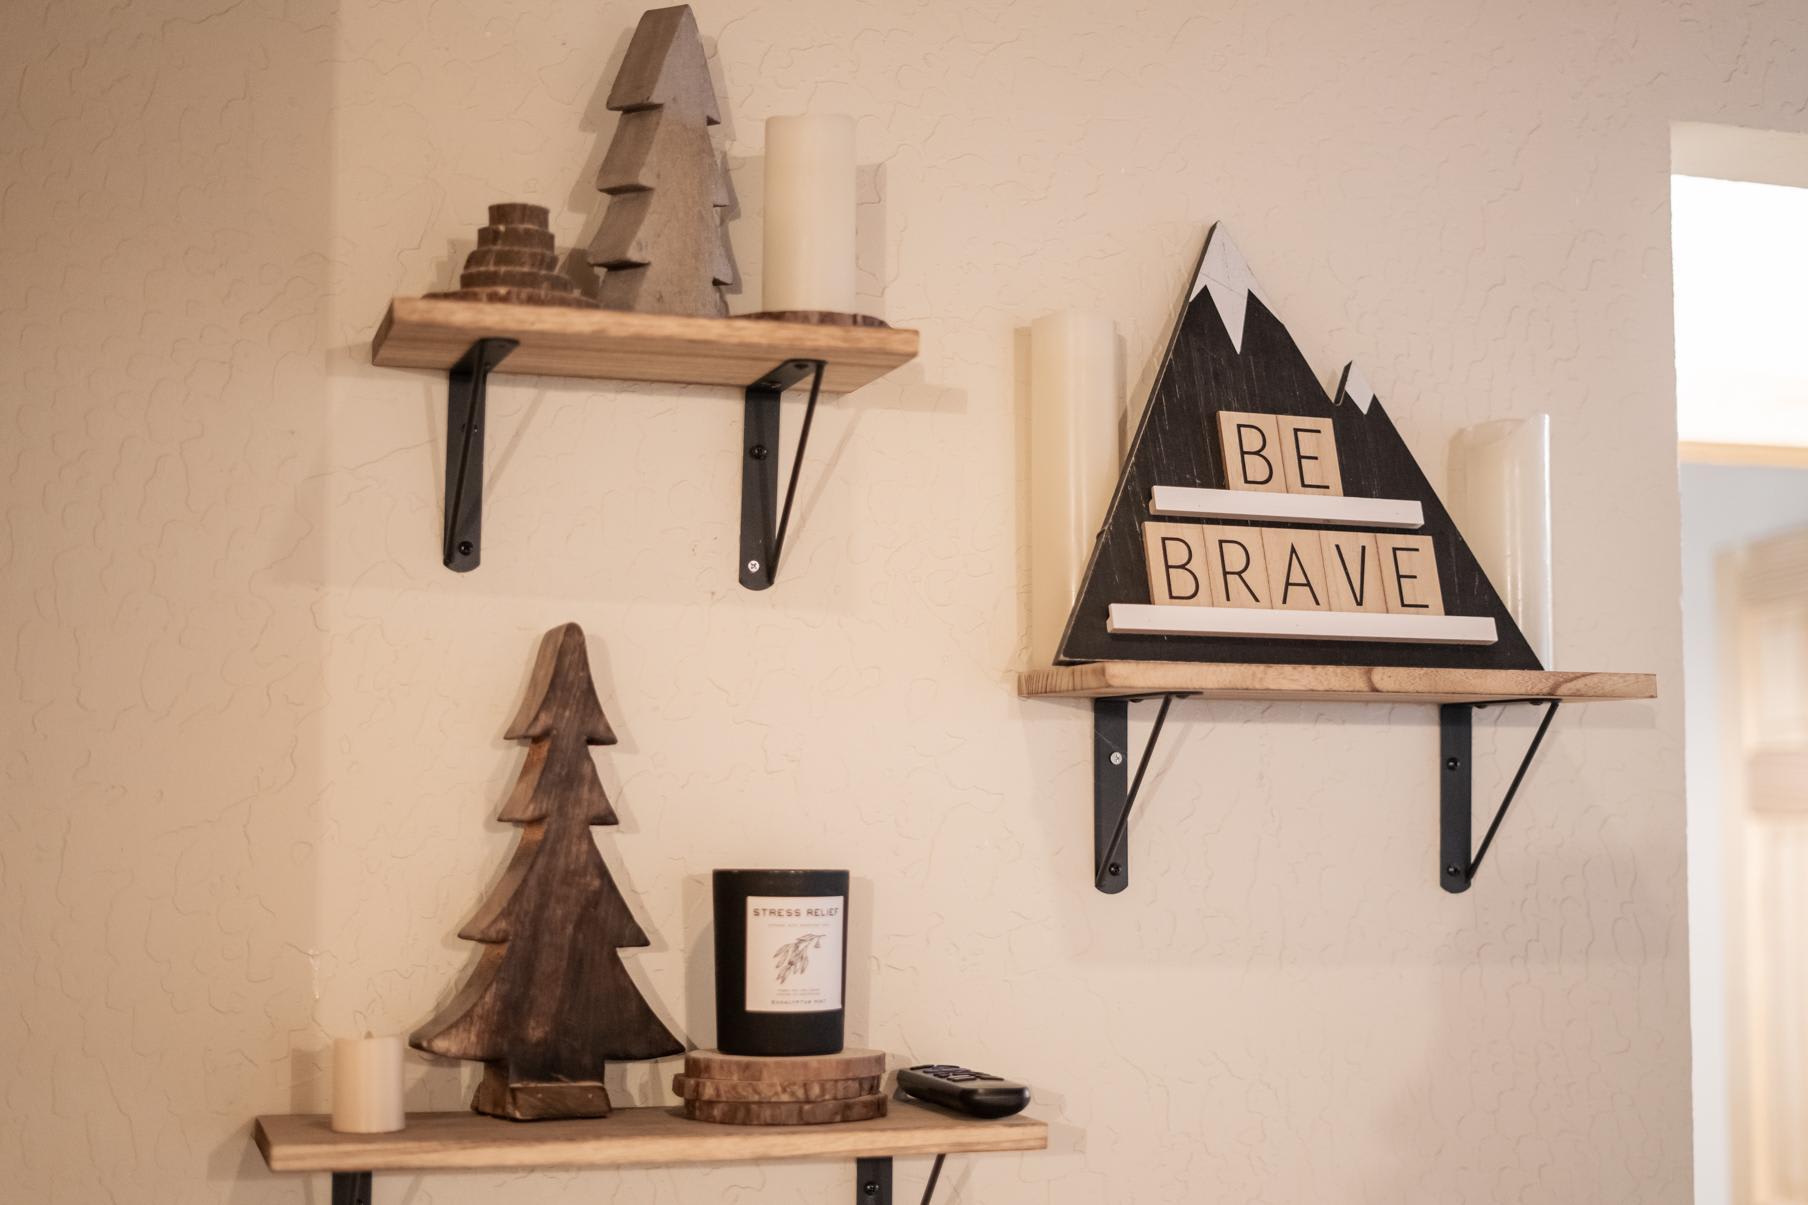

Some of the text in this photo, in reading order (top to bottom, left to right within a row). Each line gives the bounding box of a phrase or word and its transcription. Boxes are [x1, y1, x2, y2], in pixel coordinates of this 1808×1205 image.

[1235, 423, 1330, 490] BE
[1160, 536, 1429, 609] BRAVE
[753, 907, 839, 917] STRESS RELIEF
